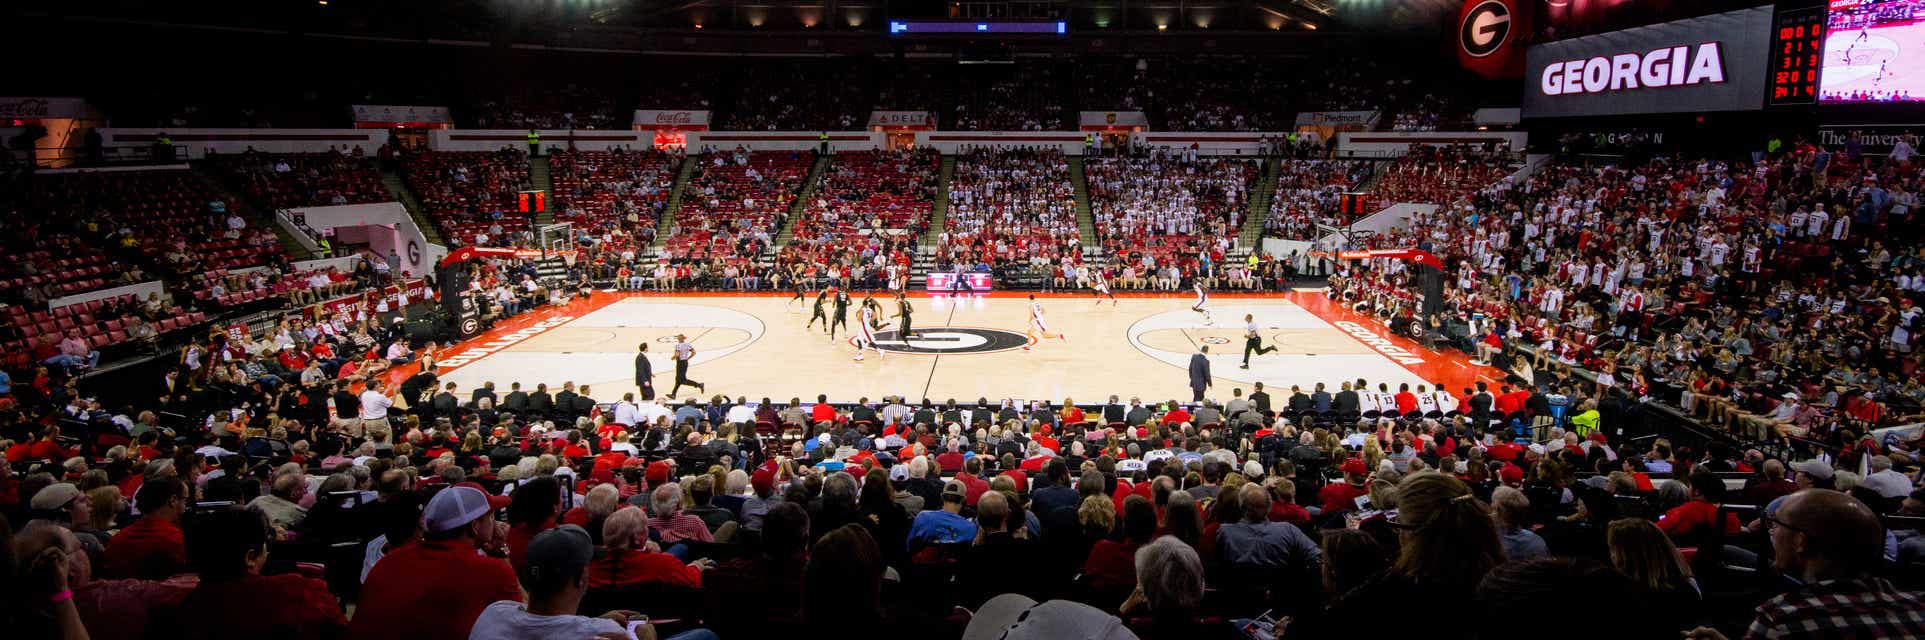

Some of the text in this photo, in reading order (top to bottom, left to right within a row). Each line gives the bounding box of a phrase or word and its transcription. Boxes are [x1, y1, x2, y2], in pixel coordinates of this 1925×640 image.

[1796, 26, 1804, 38] 0
[1812, 24, 1820, 36] 0
[1784, 40, 1819, 54] 2 1 4
[1541, 41, 1726, 96] GEORGIA
[1783, 54, 1817, 69] 3 1 3
[1791, 71, 1799, 82] 0
[1807, 70, 1815, 82] 0
[1793, 86, 1797, 97] 1
[1805, 85, 1814, 96] 4
[1818, 130, 1846, 144] The
[407, 240, 420, 266] G
[436, 316, 574, 367] BULLDOGS
[1334, 321, 1425, 365] GEORGIA
[1366, 393, 1371, 402] 1
[1384, 396, 1393, 405] 13
[1422, 396, 1433, 405] 25
